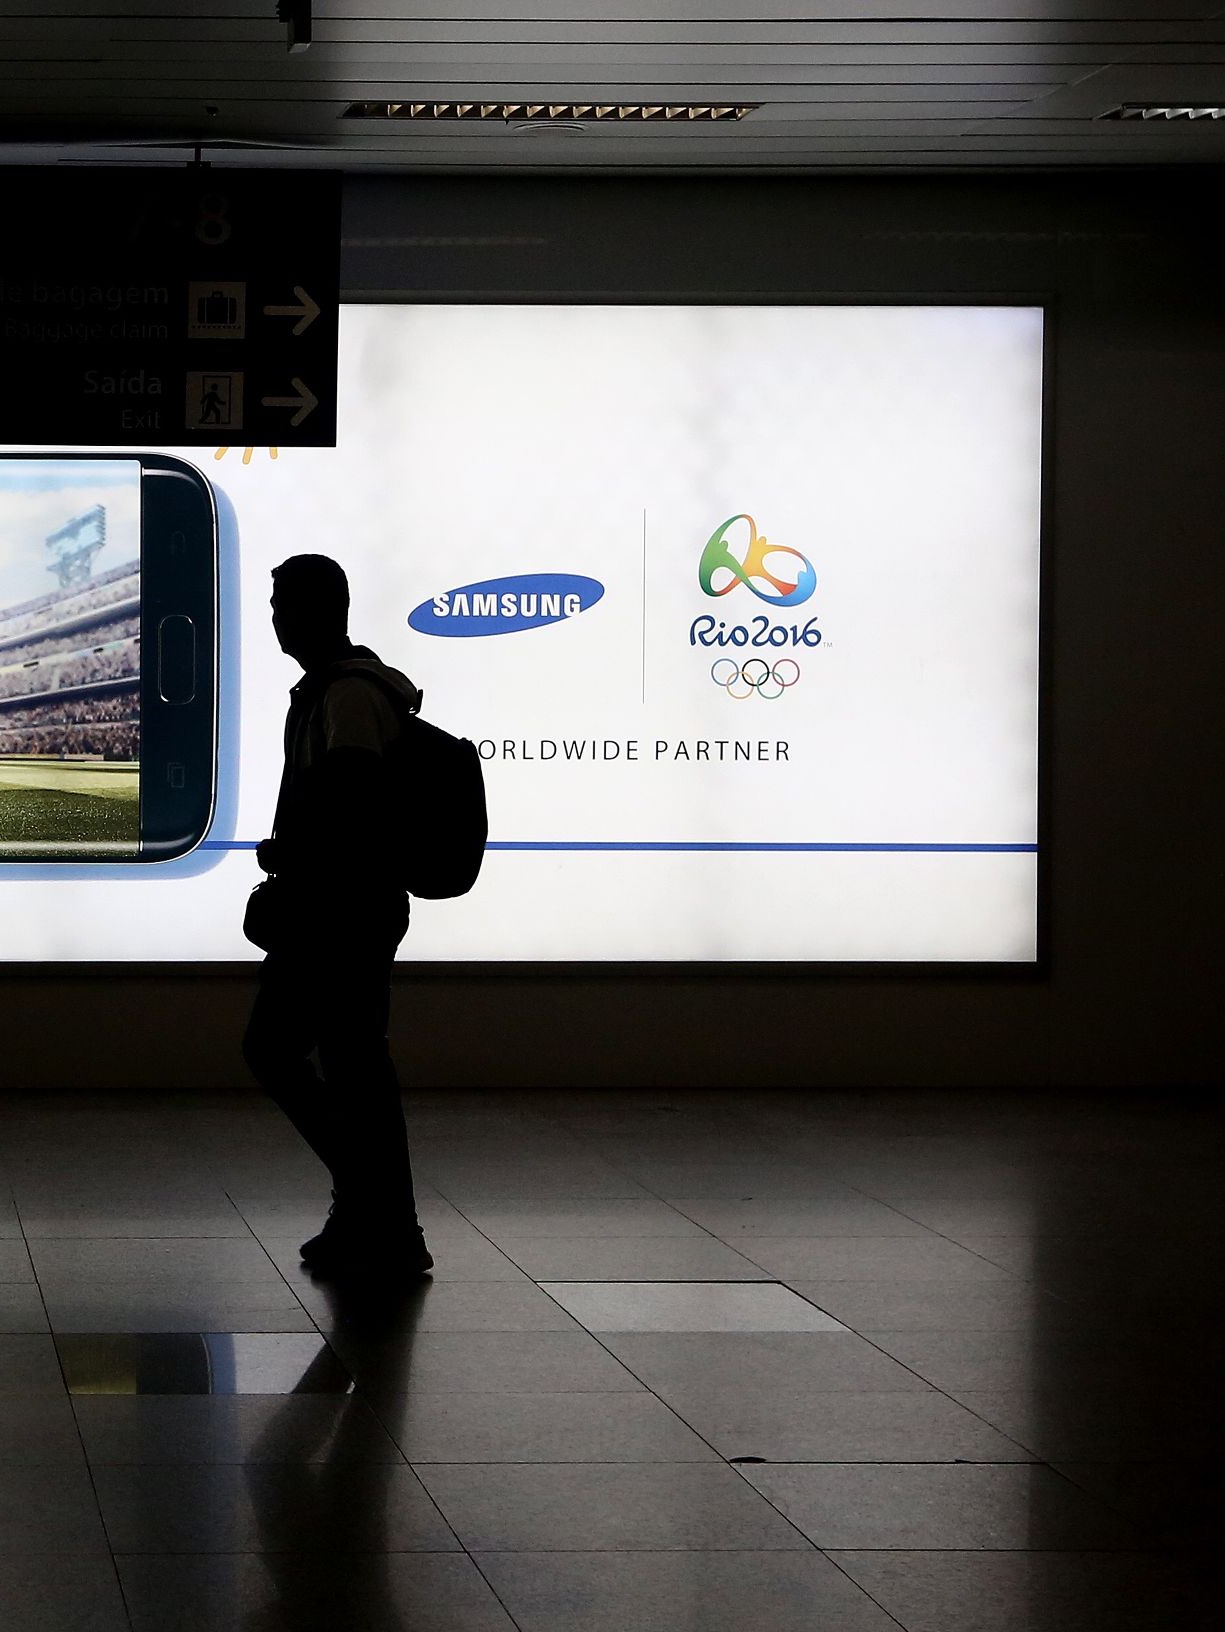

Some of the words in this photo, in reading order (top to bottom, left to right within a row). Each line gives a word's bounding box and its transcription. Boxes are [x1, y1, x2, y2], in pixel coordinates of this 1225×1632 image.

[32, 279, 169, 311] bagagem
[5, 316, 104, 344] Baggage
[109, 318, 169, 340] claim
[83, 368, 163, 395] Saída
[121, 408, 161, 429] Exit
[432, 592, 581, 618] SAMSUNG
[475, 739, 639, 761] ORLDWIDE
[655, 740, 790, 762] PARTNER
